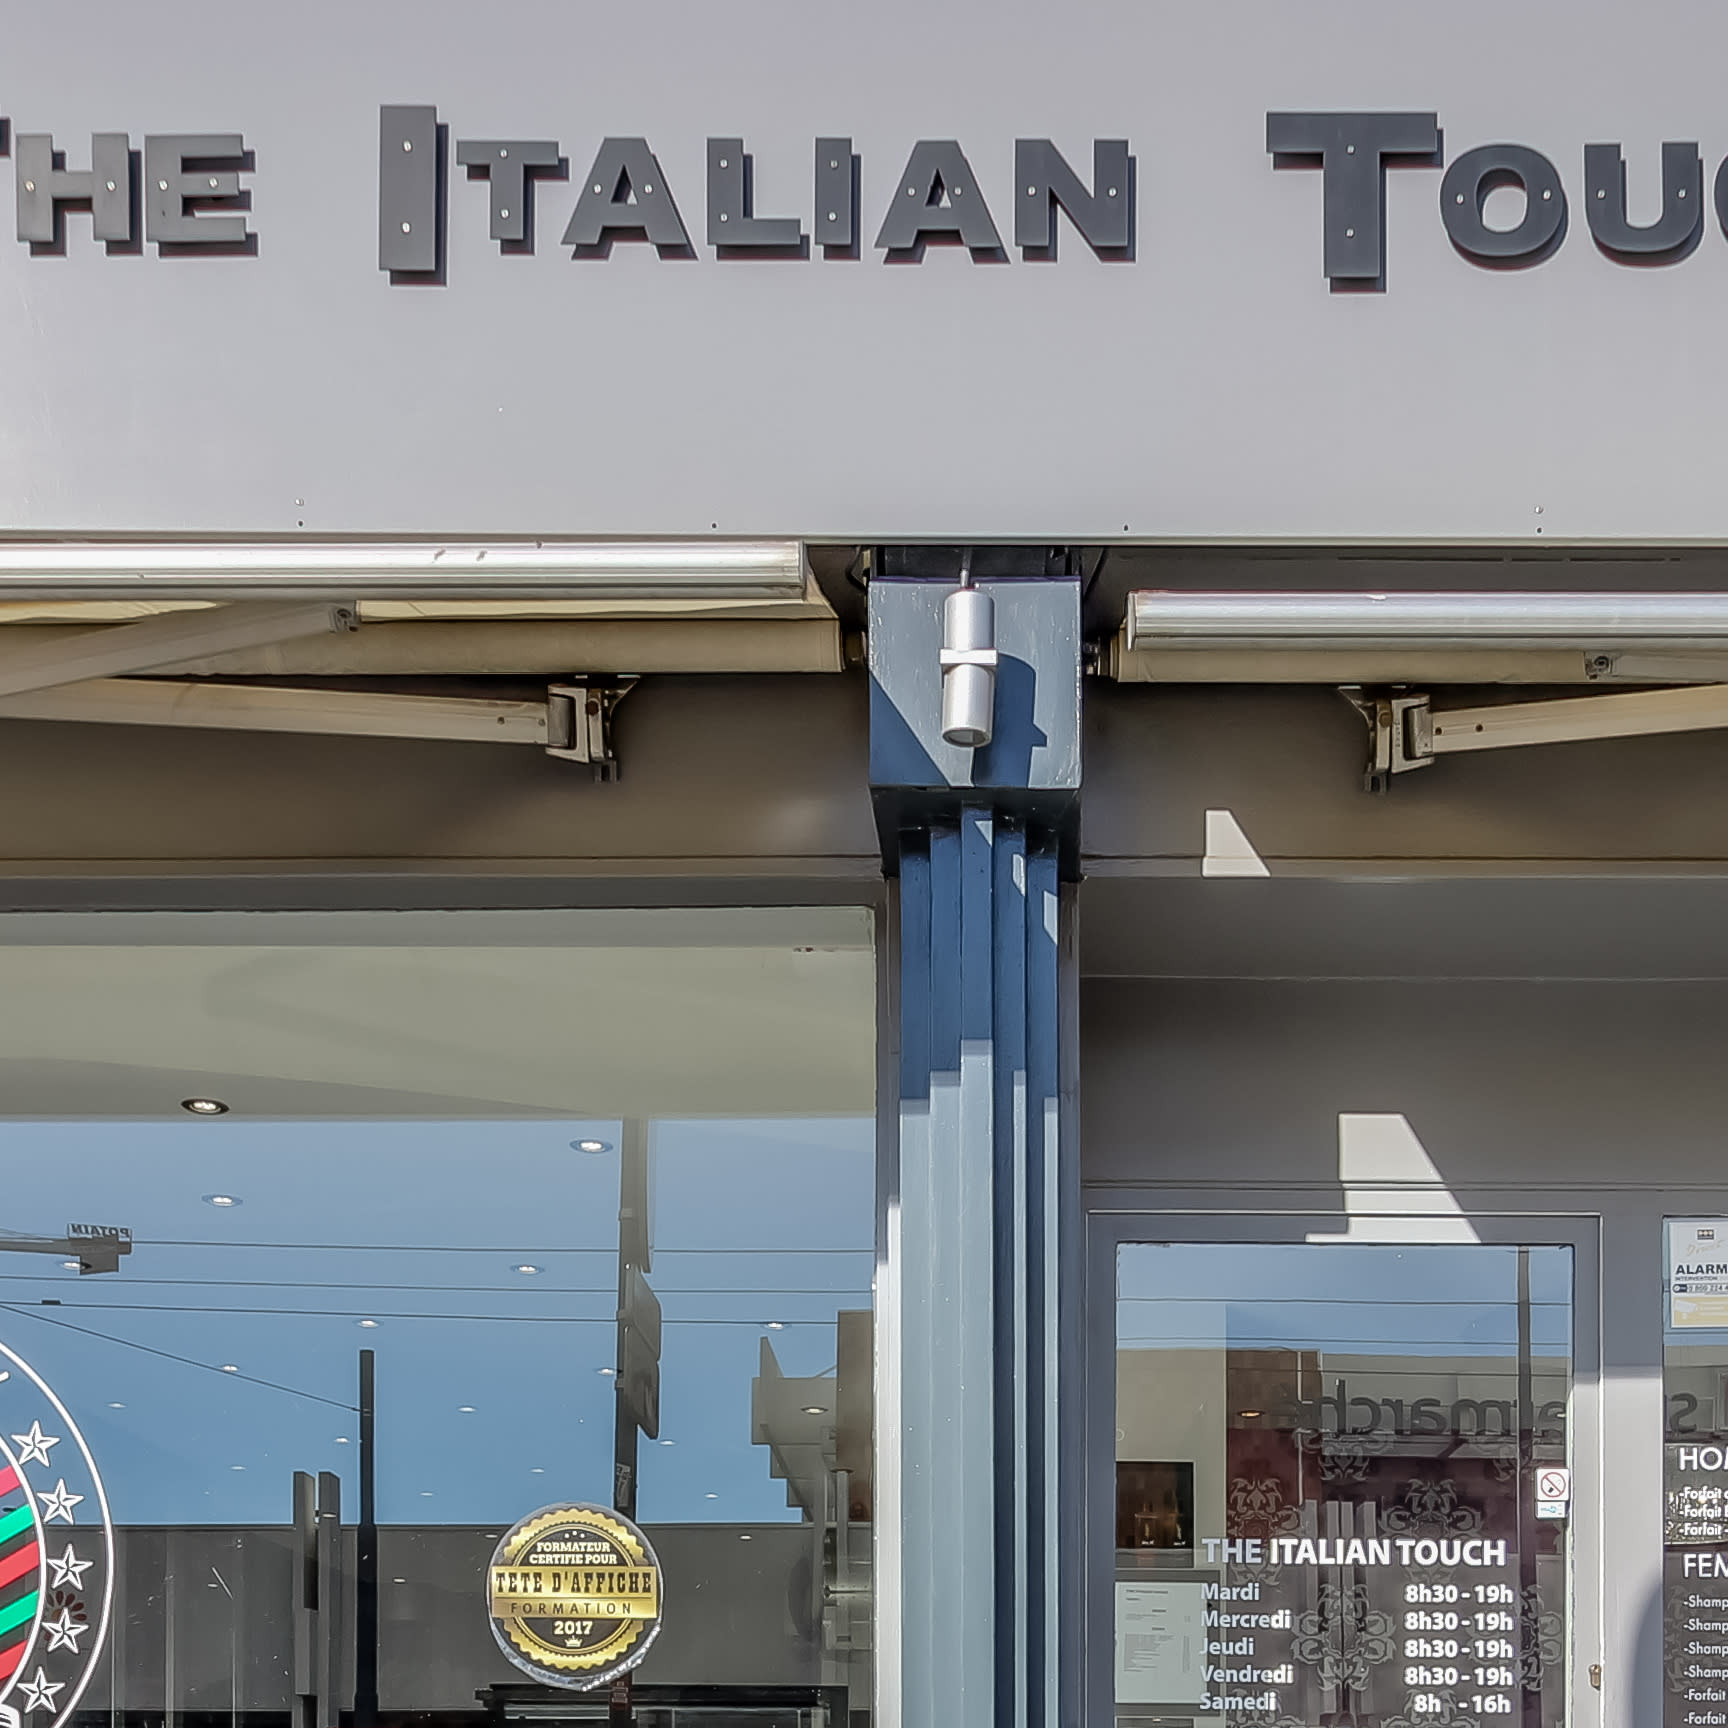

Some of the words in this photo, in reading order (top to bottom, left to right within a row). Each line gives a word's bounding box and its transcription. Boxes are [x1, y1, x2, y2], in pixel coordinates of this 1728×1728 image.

[379, 104, 1137, 286] ITALIAN
[536, 1541, 611, 1553] FORMATEUR
[1201, 1537, 1262, 1566] THE
[1270, 1537, 1391, 1566] ITALIAN
[1397, 1538, 1506, 1567] TOUCH
[529, 1554, 584, 1564] CERTIFIE
[585, 1554, 617, 1564] POUR
[496, 1572, 542, 1593] TETE
[552, 1571, 651, 1593] D'AFFICHE
[1200, 1582, 1260, 1602] Mardi
[1405, 1584, 1457, 1604] 8h30
[1474, 1584, 1513, 1604] 19h
[511, 1602, 631, 1614] FORMATION
[554, 1621, 593, 1635] 2017
[1200, 1609, 1291, 1630] Mercredi
[1404, 1612, 1457, 1632] 8h30
[1474, 1612, 1513, 1632] 19h
[1200, 1637, 1254, 1658] Jeudi
[1404, 1639, 1457, 1659] 8h30
[1474, 1639, 1513, 1659] 19h
[1200, 1664, 1293, 1684] Vendredi
[1404, 1666, 1457, 1686] 8h30
[1474, 1666, 1513, 1686] 19h
[1200, 1691, 1276, 1712] Samedi
[1414, 1694, 1441, 1714] 8h
[1472, 1694, 1511, 1714] 16h
